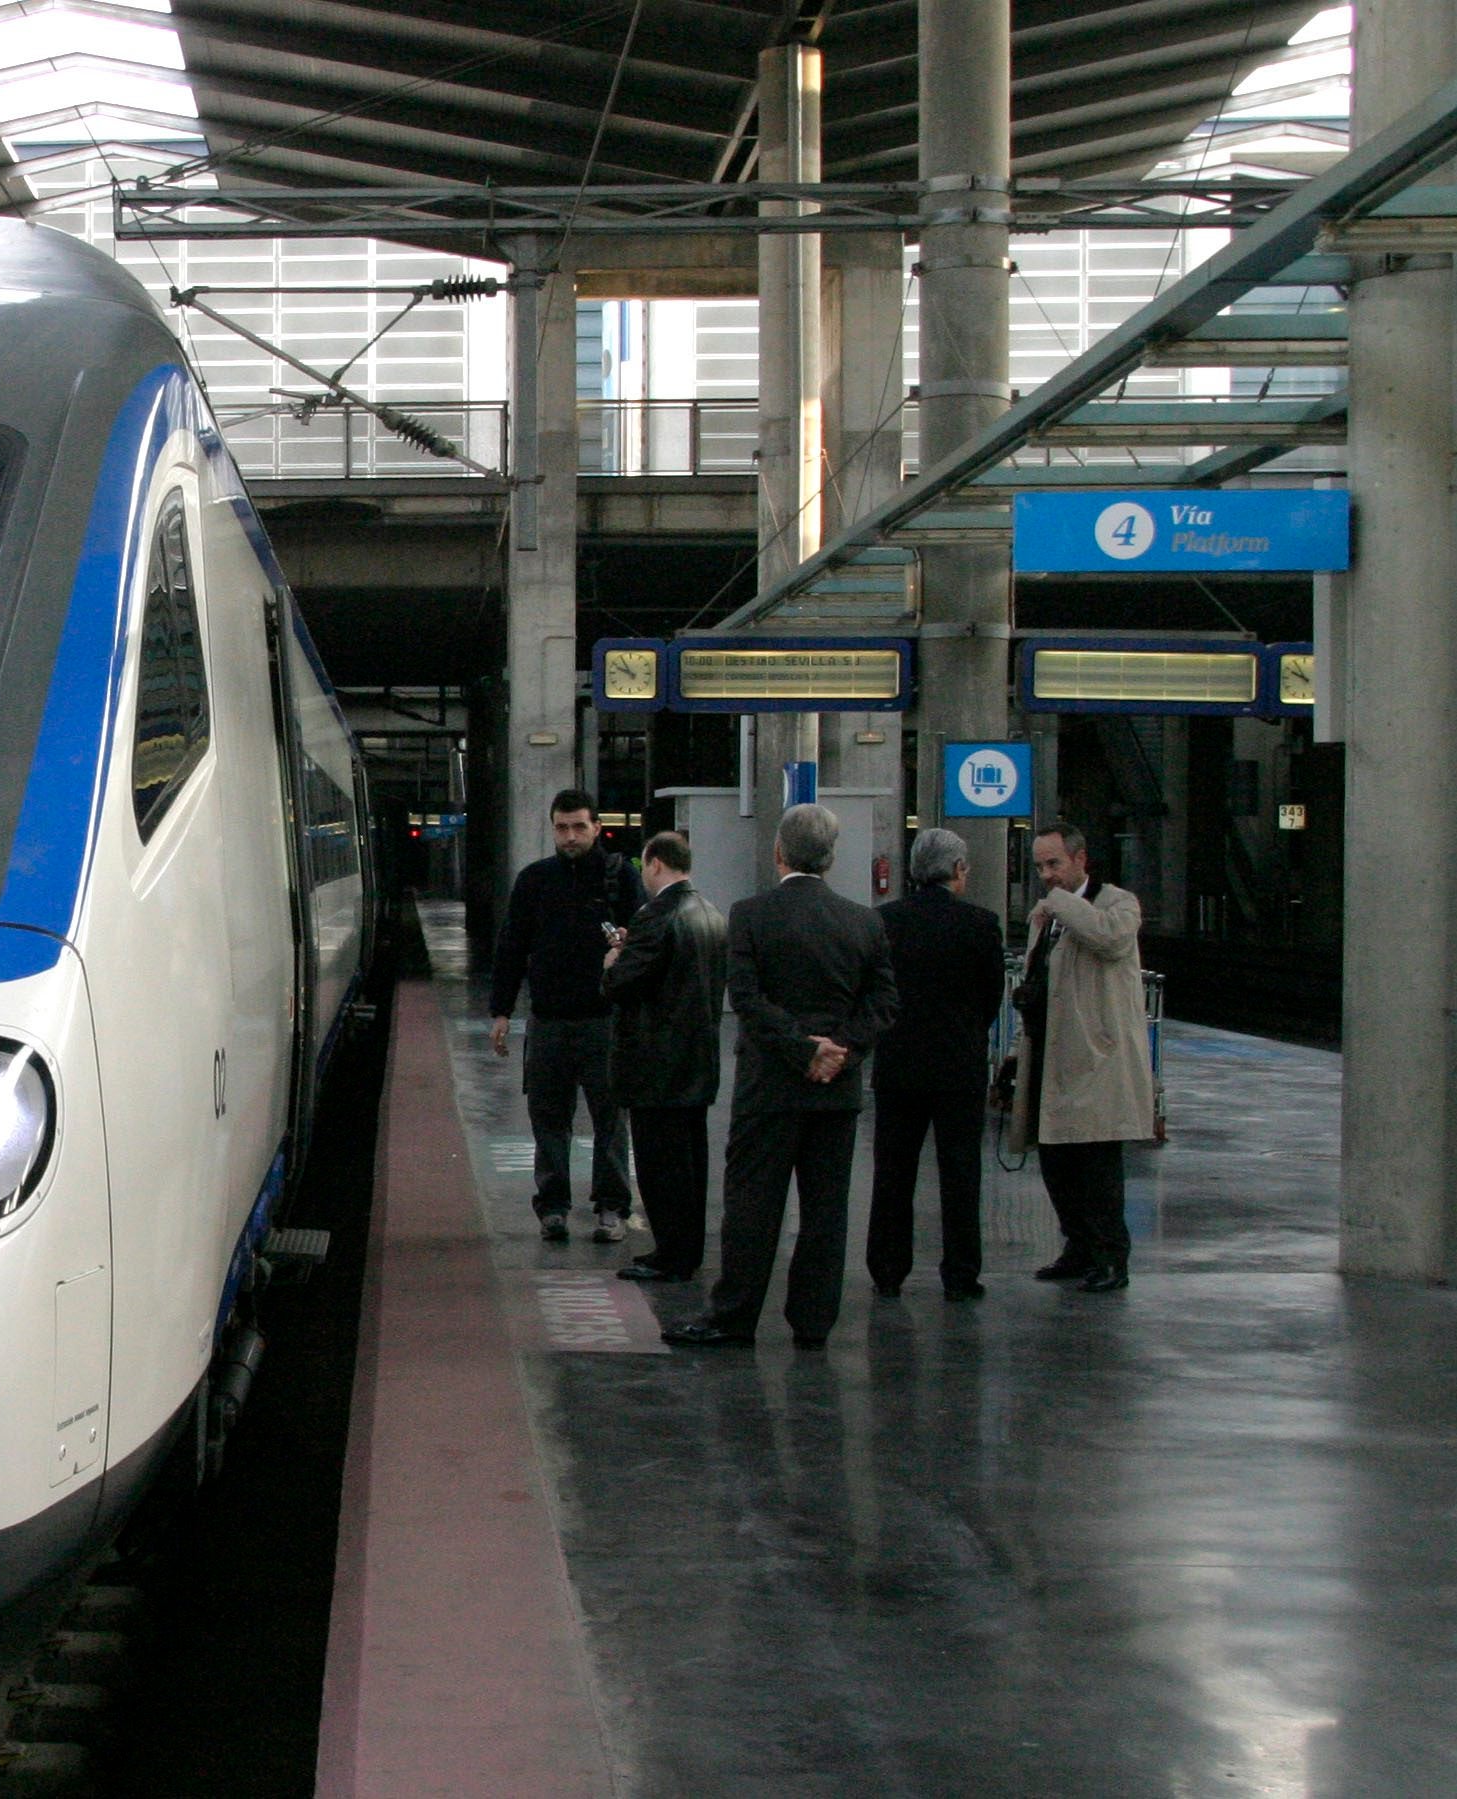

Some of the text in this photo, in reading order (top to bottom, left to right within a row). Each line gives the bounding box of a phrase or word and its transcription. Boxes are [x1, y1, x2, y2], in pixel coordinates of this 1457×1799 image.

[1170, 504, 1215, 526] Vía
[1111, 514, 1137, 547] 4
[1171, 532, 1270, 557] Platform
[785, 655, 836, 666] SEVILLA
[1280, 806, 1304, 816] 343
[536, 1287, 633, 1345] SECTOR
